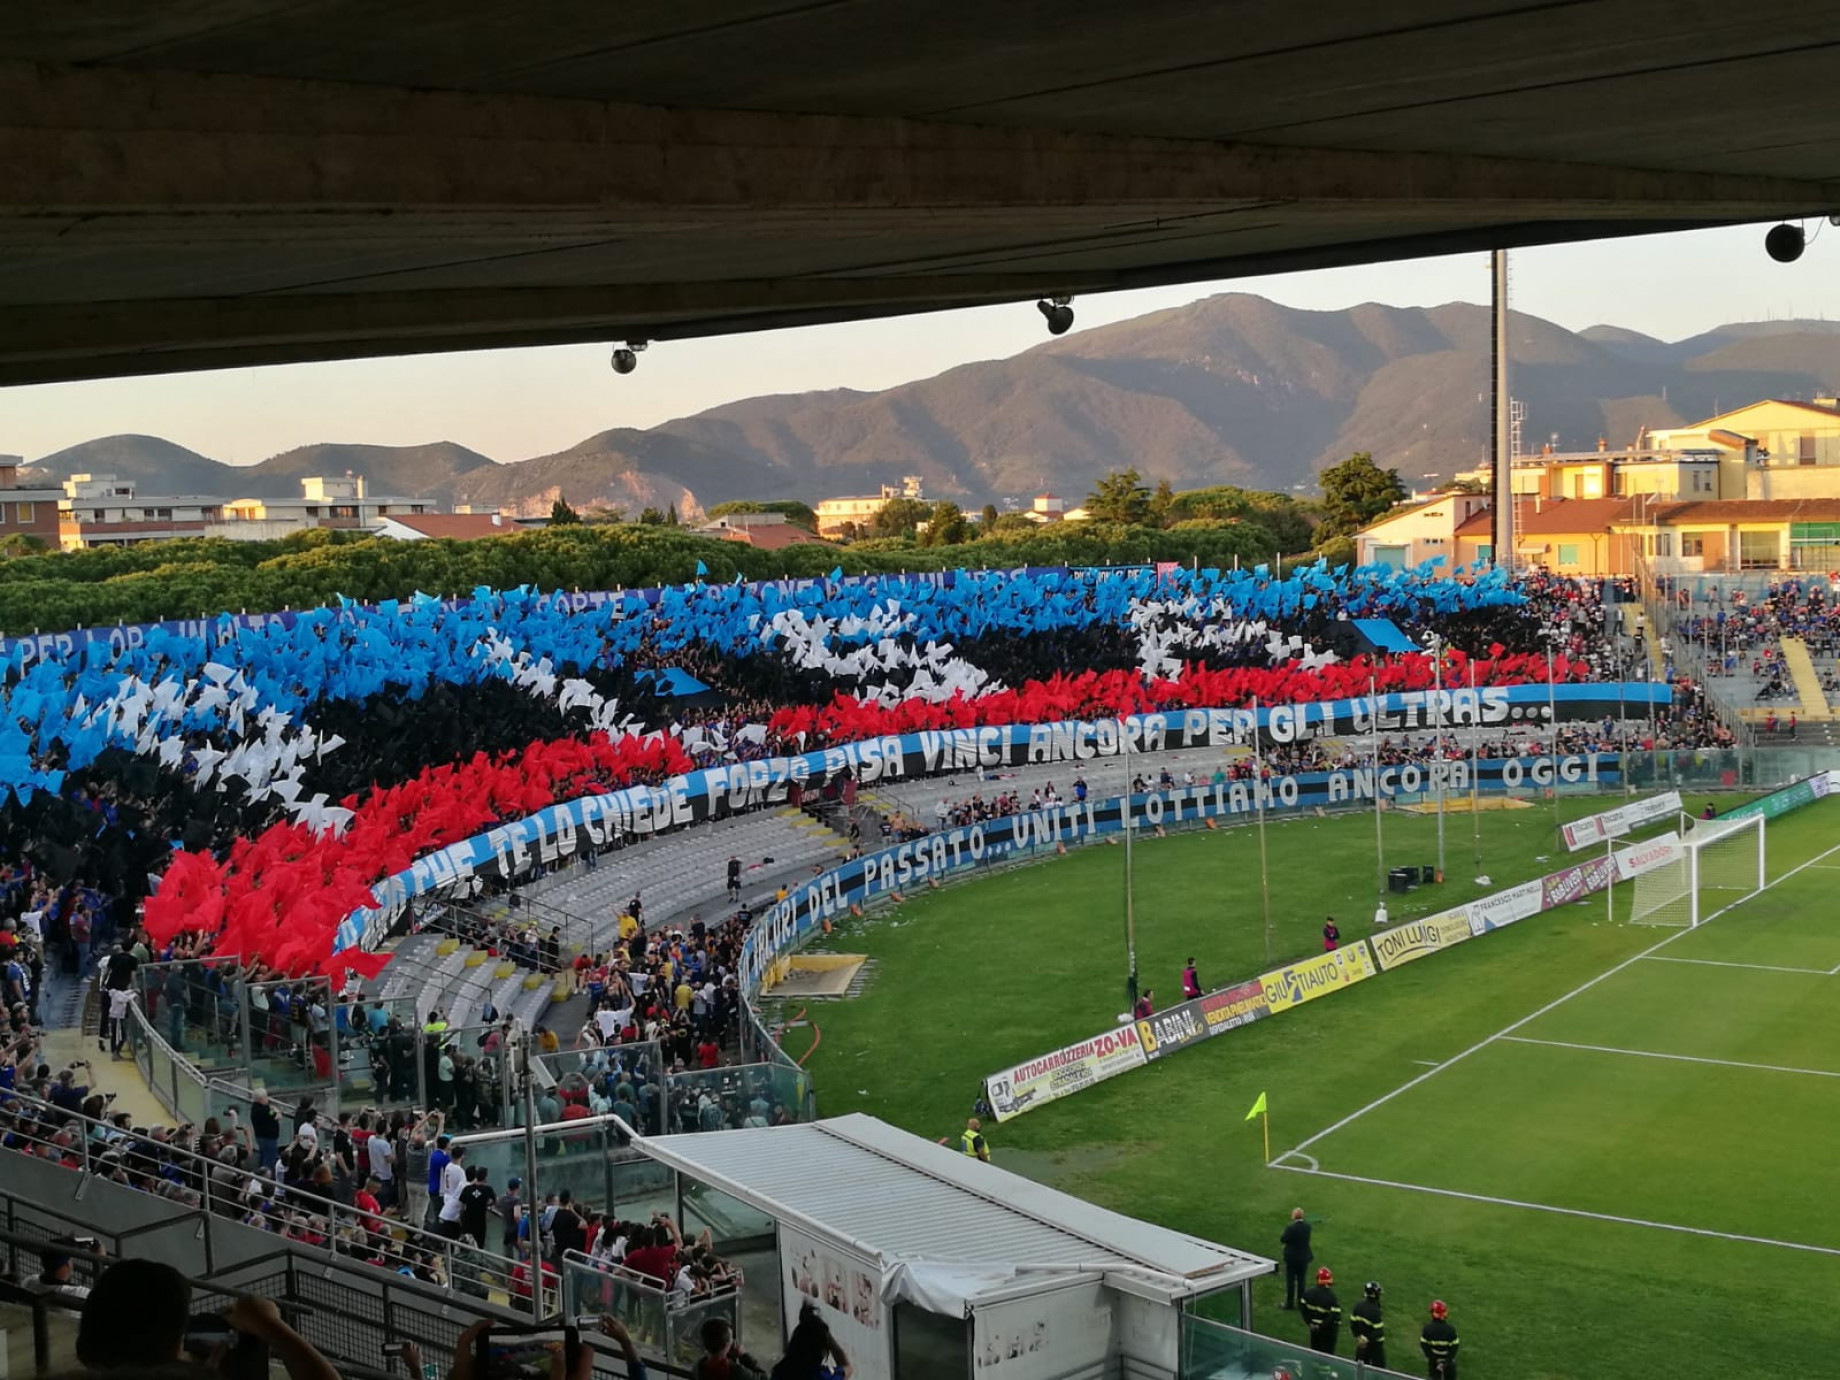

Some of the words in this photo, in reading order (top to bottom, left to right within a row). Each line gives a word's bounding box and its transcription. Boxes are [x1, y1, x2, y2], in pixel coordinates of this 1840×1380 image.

[488, 826, 533, 878] TE
[533, 804, 577, 864] LO
[581, 775, 694, 844] CHIEDE
[823, 735, 905, 784] PISA
[919, 725, 1013, 772] VINCI
[1027, 714, 1167, 762] ANCORA
[1183, 707, 1254, 746] PER
[808, 871, 848, 925] DEL
[1121, 776, 1299, 829] LOTTIAMO
[1328, 760, 1469, 801] ANCORA
[1503, 754, 1598, 787] OGGI
[1378, 934, 1406, 961] TONI
[1408, 923, 1441, 945] LUIGI
[1265, 962, 1338, 1004] GIUSTIAUTO
[1013, 1047, 1095, 1085] AUTOCARROZZERIA
[1094, 1027, 1138, 1059] ZO-VA
[1137, 1009, 1197, 1053] BABINI
